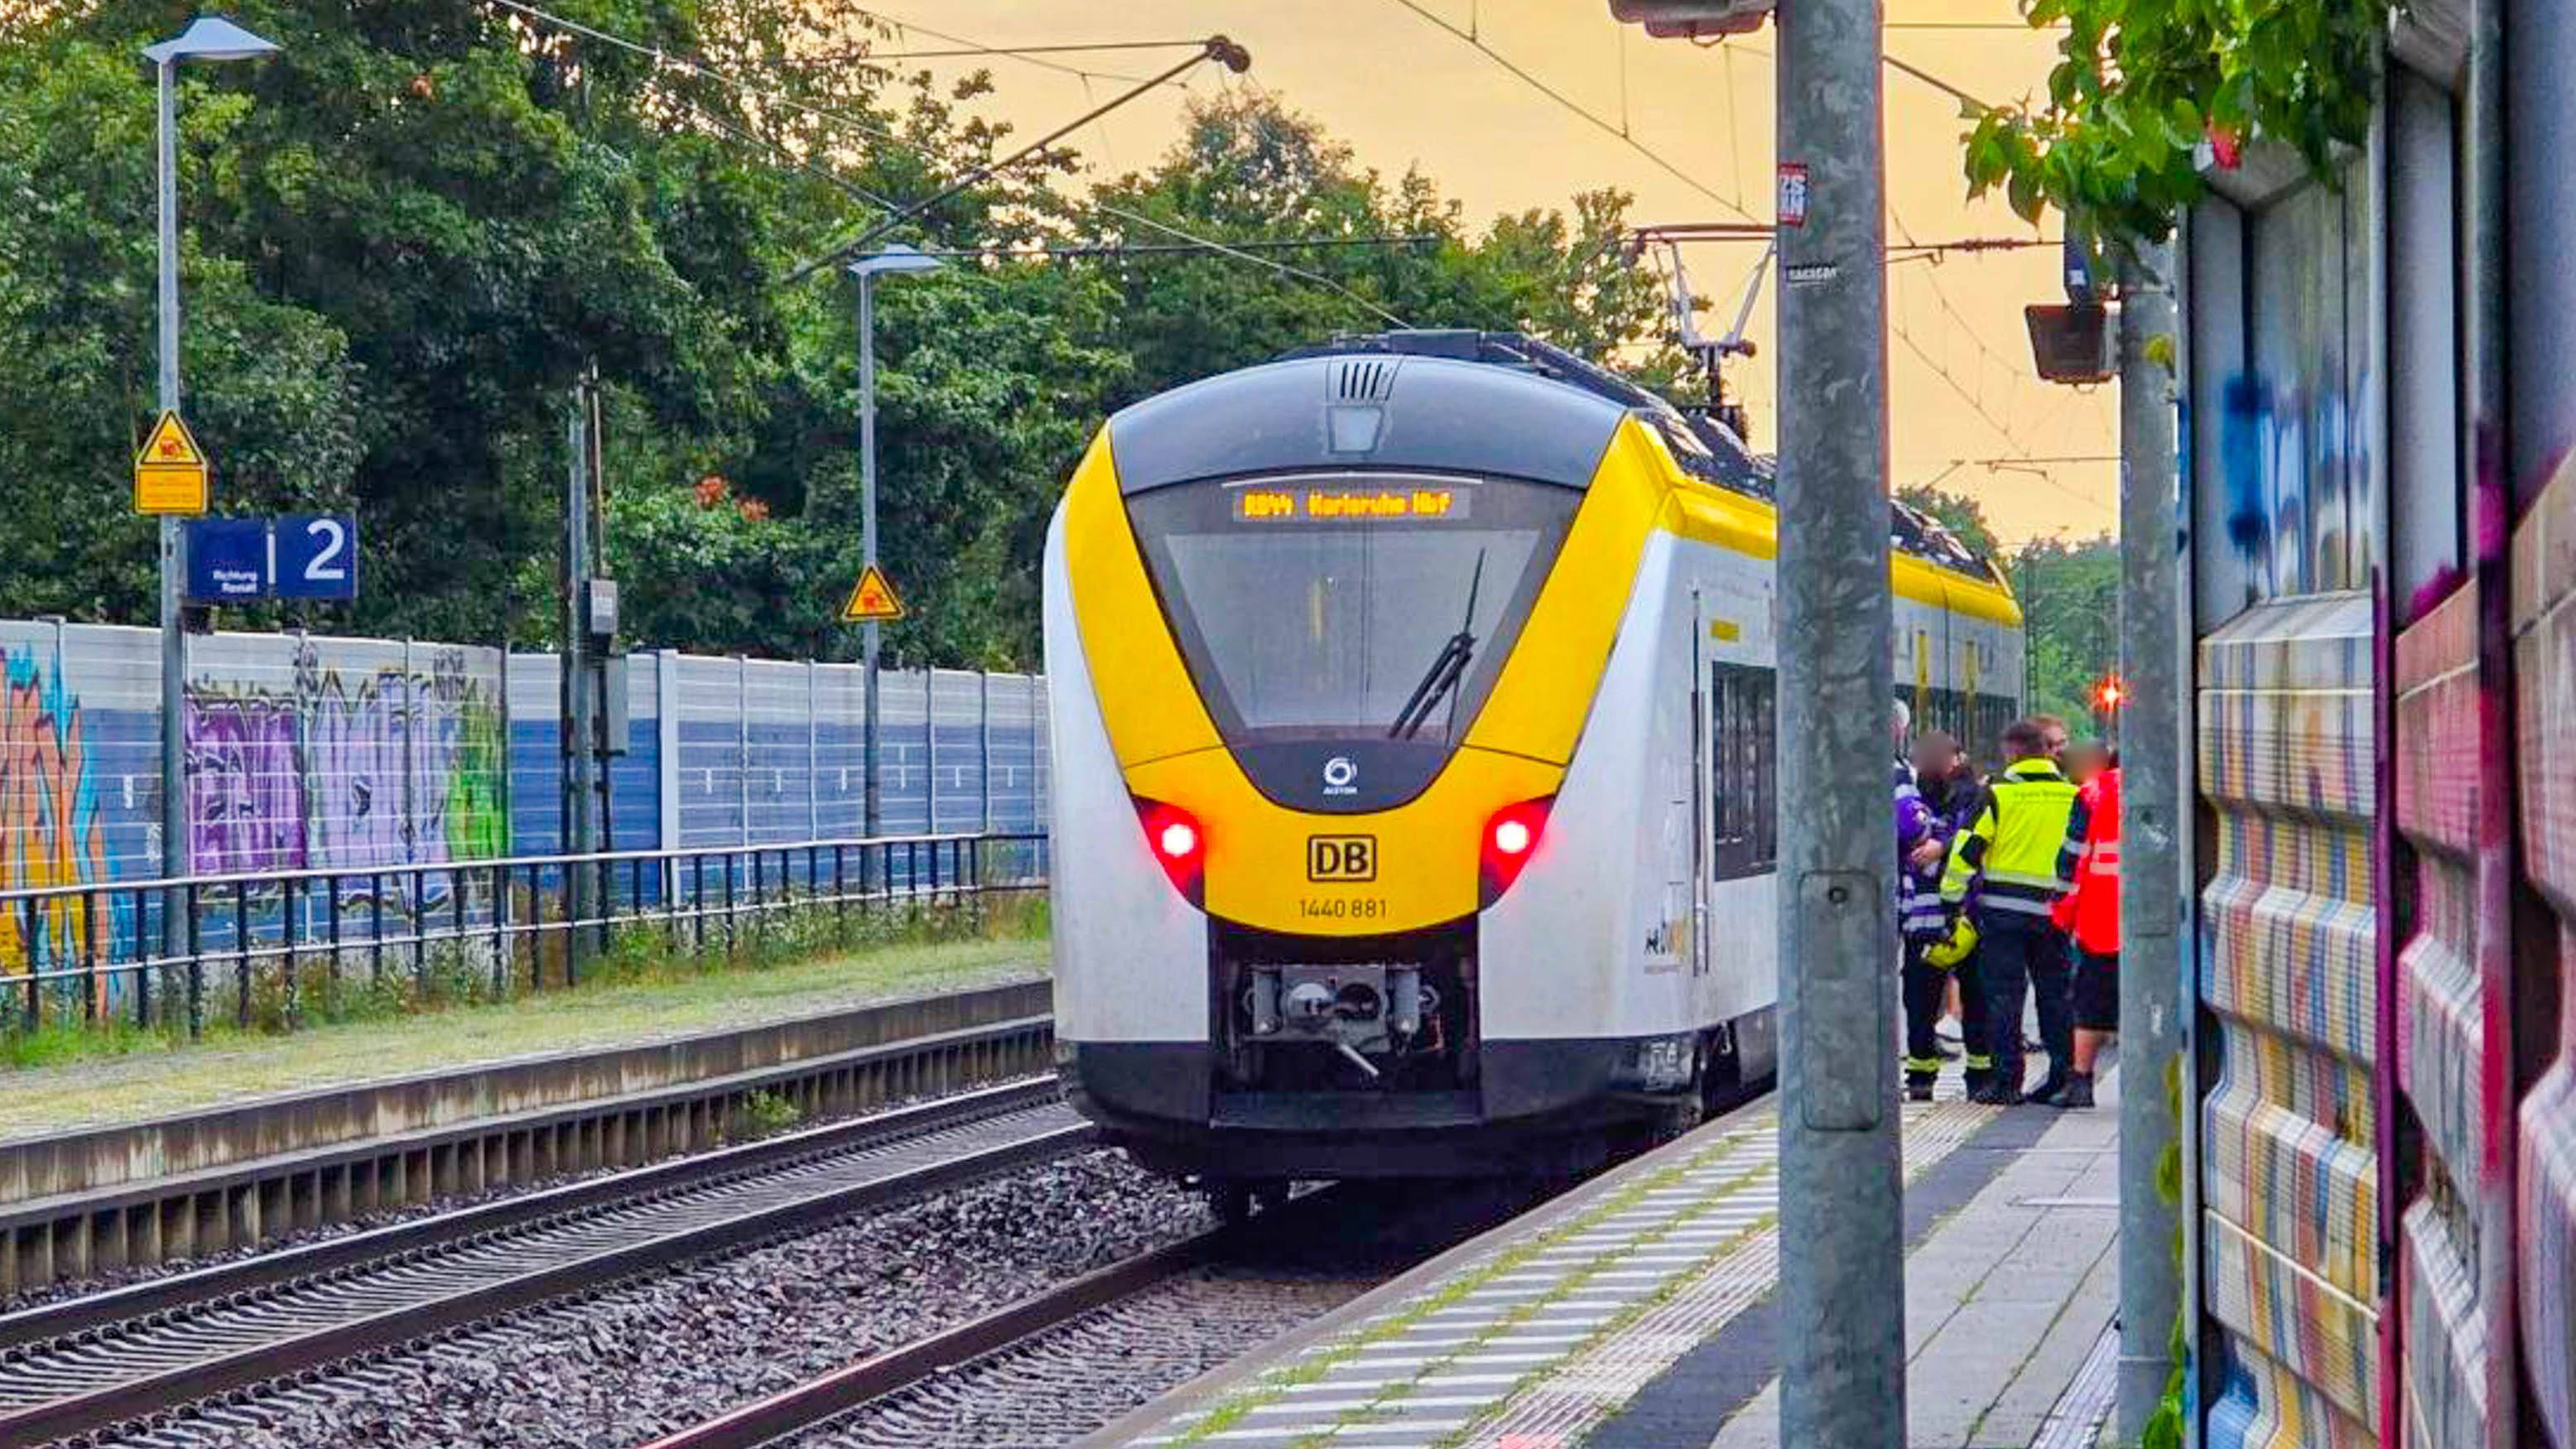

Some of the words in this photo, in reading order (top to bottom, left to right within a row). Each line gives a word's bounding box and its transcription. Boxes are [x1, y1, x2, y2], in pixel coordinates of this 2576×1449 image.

[1308, 492, 1406, 515] Karlsruhe
[1412, 492, 1451, 513] Hbf
[304, 518, 345, 580] 2
[1314, 840, 1370, 875] DB
[1299, 899, 1346, 918] 1440
[1351, 899, 1386, 918] 881
